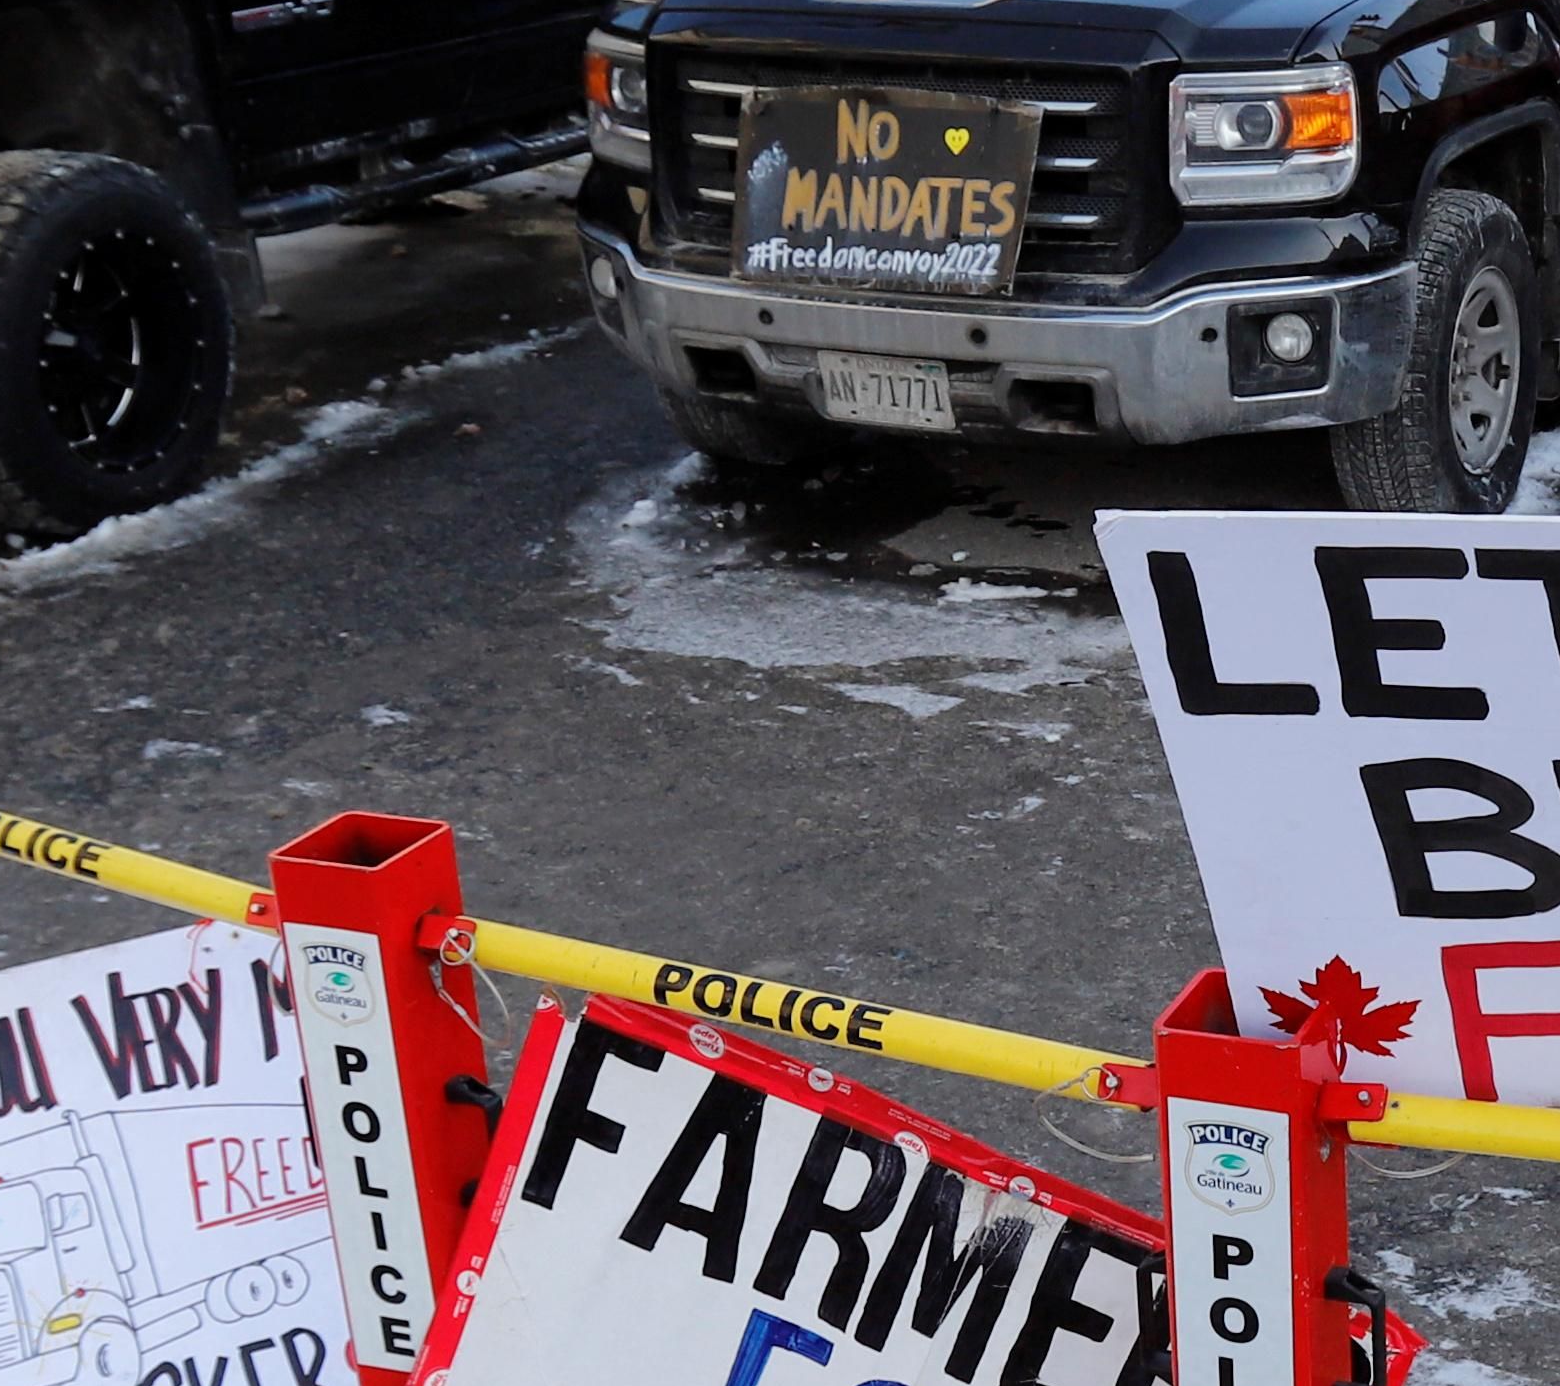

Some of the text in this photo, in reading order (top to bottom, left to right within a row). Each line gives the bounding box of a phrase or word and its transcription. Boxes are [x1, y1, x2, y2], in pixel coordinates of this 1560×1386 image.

[835, 98, 902, 165] NO
[781, 166, 1018, 241] MANDATES
[306, 946, 363, 970] POLICE
[314, 989, 368, 1009] Gatineau
[653, 964, 893, 1051] POLICE
[72, 965, 223, 1102] VERY
[1191, 1125, 1267, 1154] POLICE
[335, 1044, 418, 1358] POLICE
[1196, 1173, 1263, 1195] Gatineau
